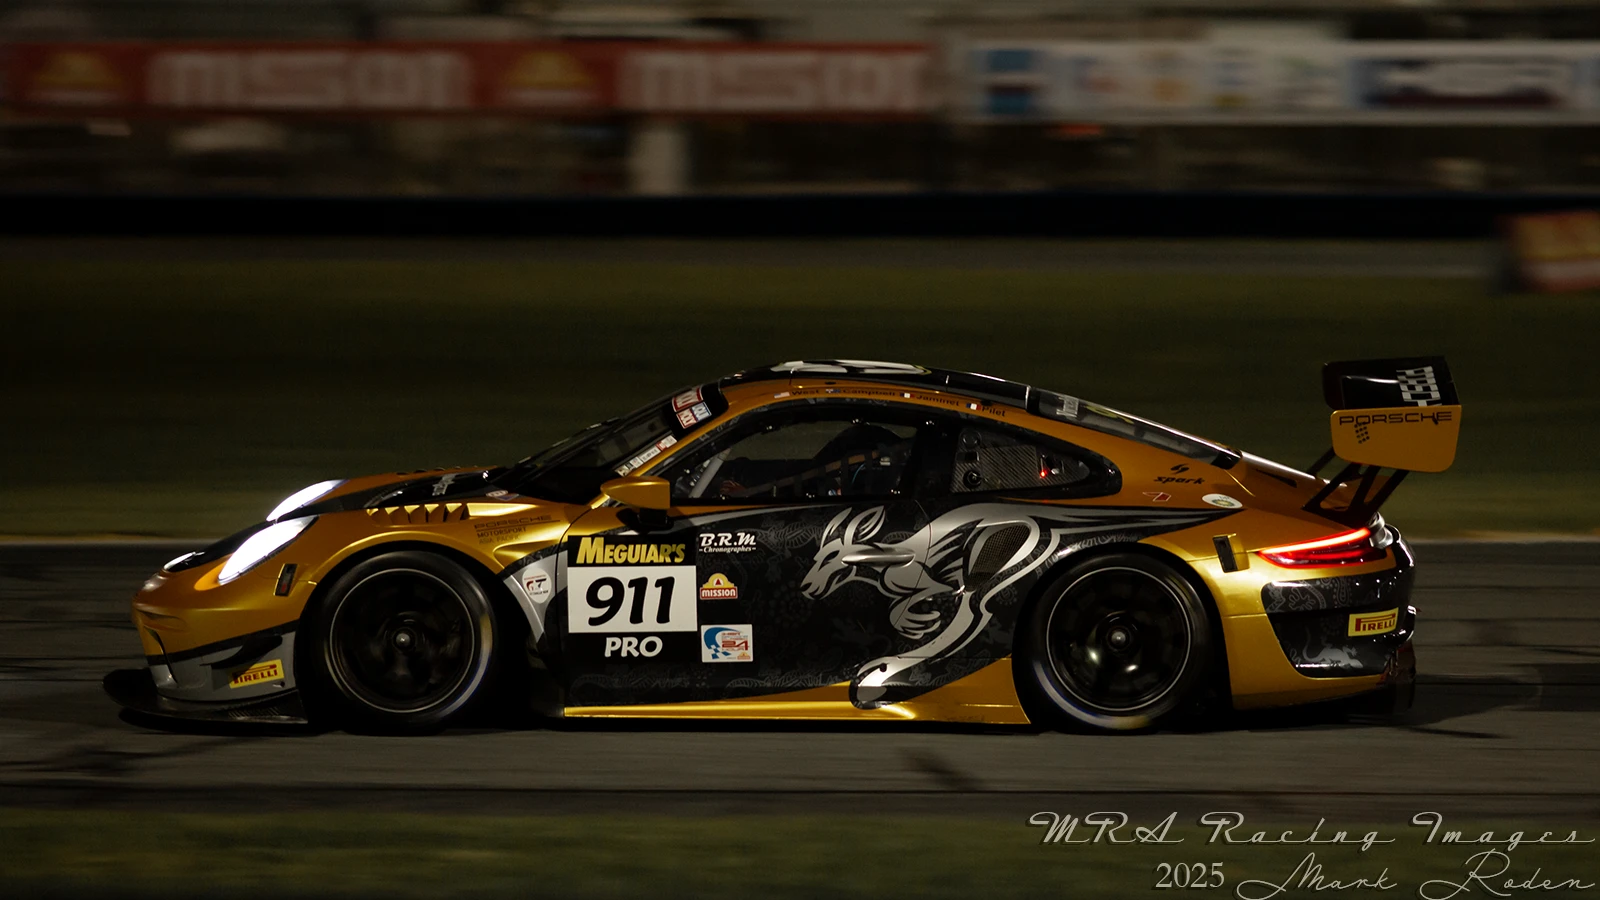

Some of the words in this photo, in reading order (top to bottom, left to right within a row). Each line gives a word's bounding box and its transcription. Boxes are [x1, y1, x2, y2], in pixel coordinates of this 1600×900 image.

[982, 405, 1006, 416] Pilet
[1339, 412, 1452, 425] PORSCHE
[1153, 476, 1205, 484] spark
[476, 526, 526, 538] MOTORSPORT
[702, 588, 736, 597] MISSION
[586, 576, 675, 626] 911
[1355, 612, 1396, 631] PIRELLI
[604, 636, 663, 658] PRO
[232, 665, 278, 684] PIRELLI
